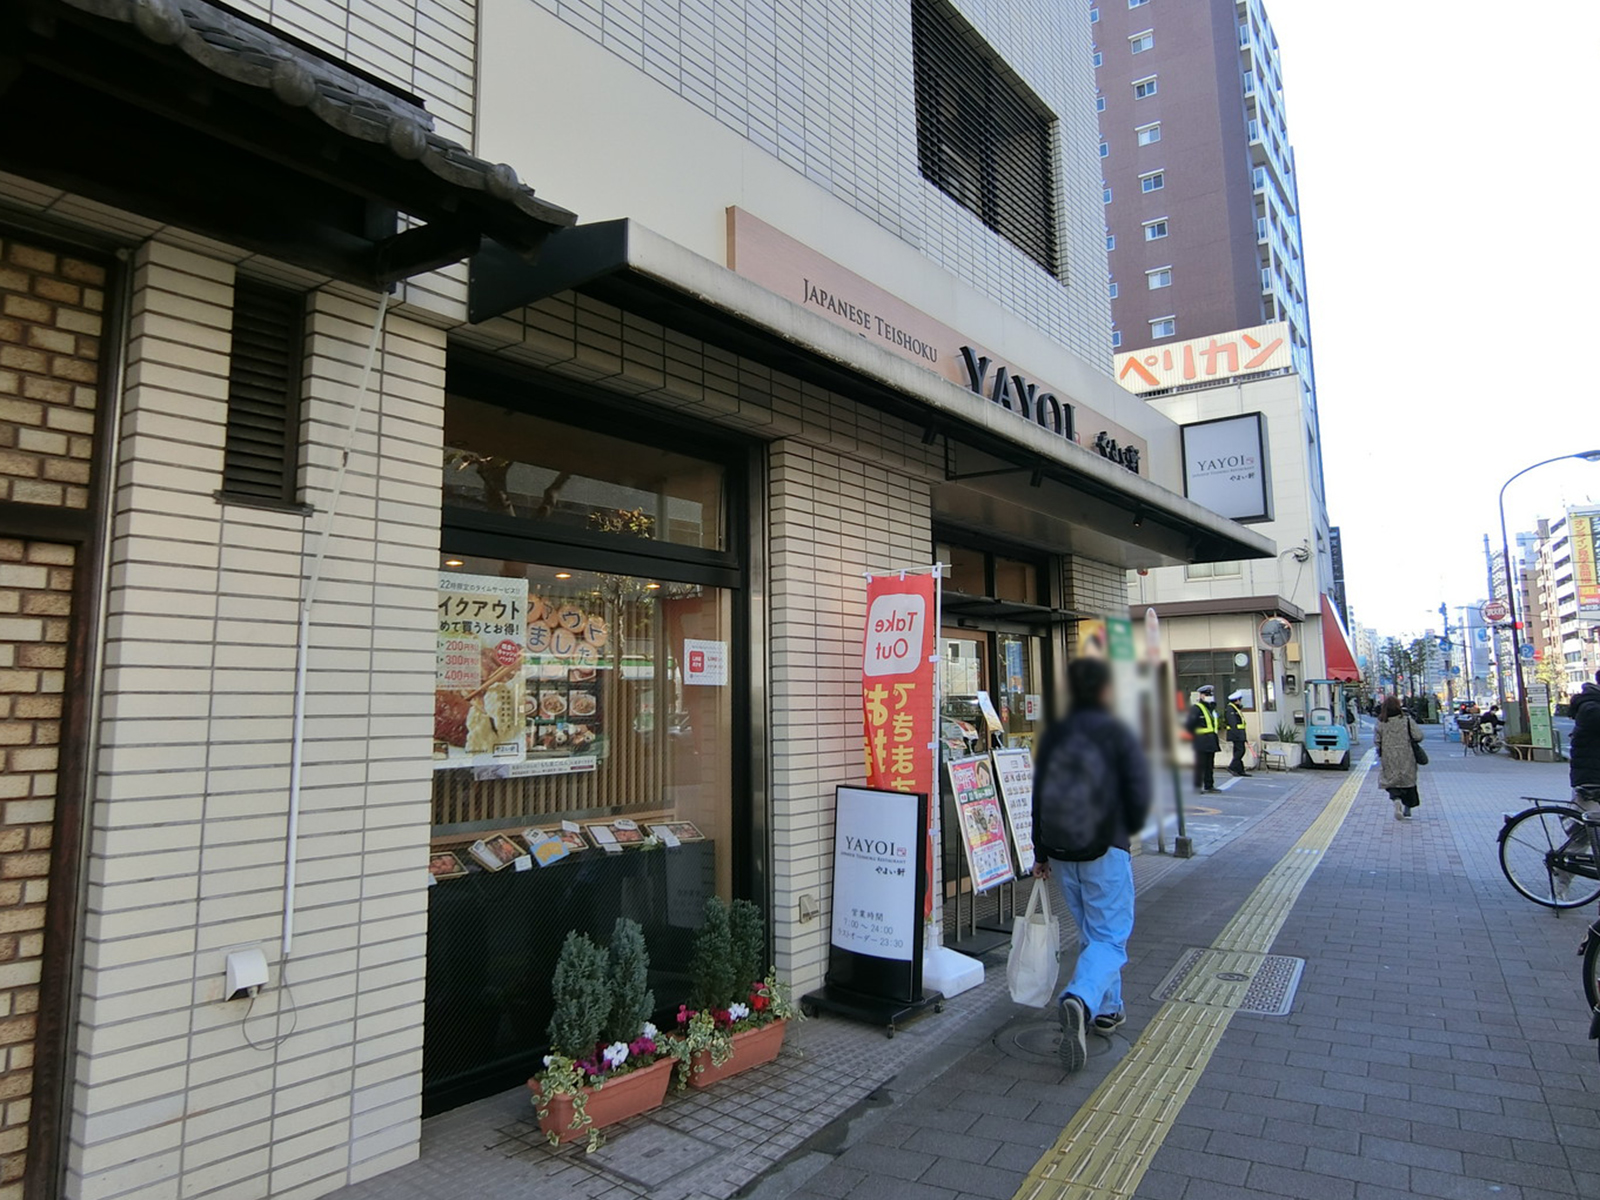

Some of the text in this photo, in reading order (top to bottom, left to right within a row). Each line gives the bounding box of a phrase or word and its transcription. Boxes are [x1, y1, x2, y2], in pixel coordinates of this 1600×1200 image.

[803, 278, 938, 363] JAPANESE TEISHOKU
[1119, 334, 1284, 386] ペリカン
[959, 346, 1076, 441] YAYOI
[1197, 455, 1245, 471] YAYOI
[845, 836, 895, 856] YAYOI
[871, 924, 893, 935] 24:00
[880, 937, 904, 948] 23:30
